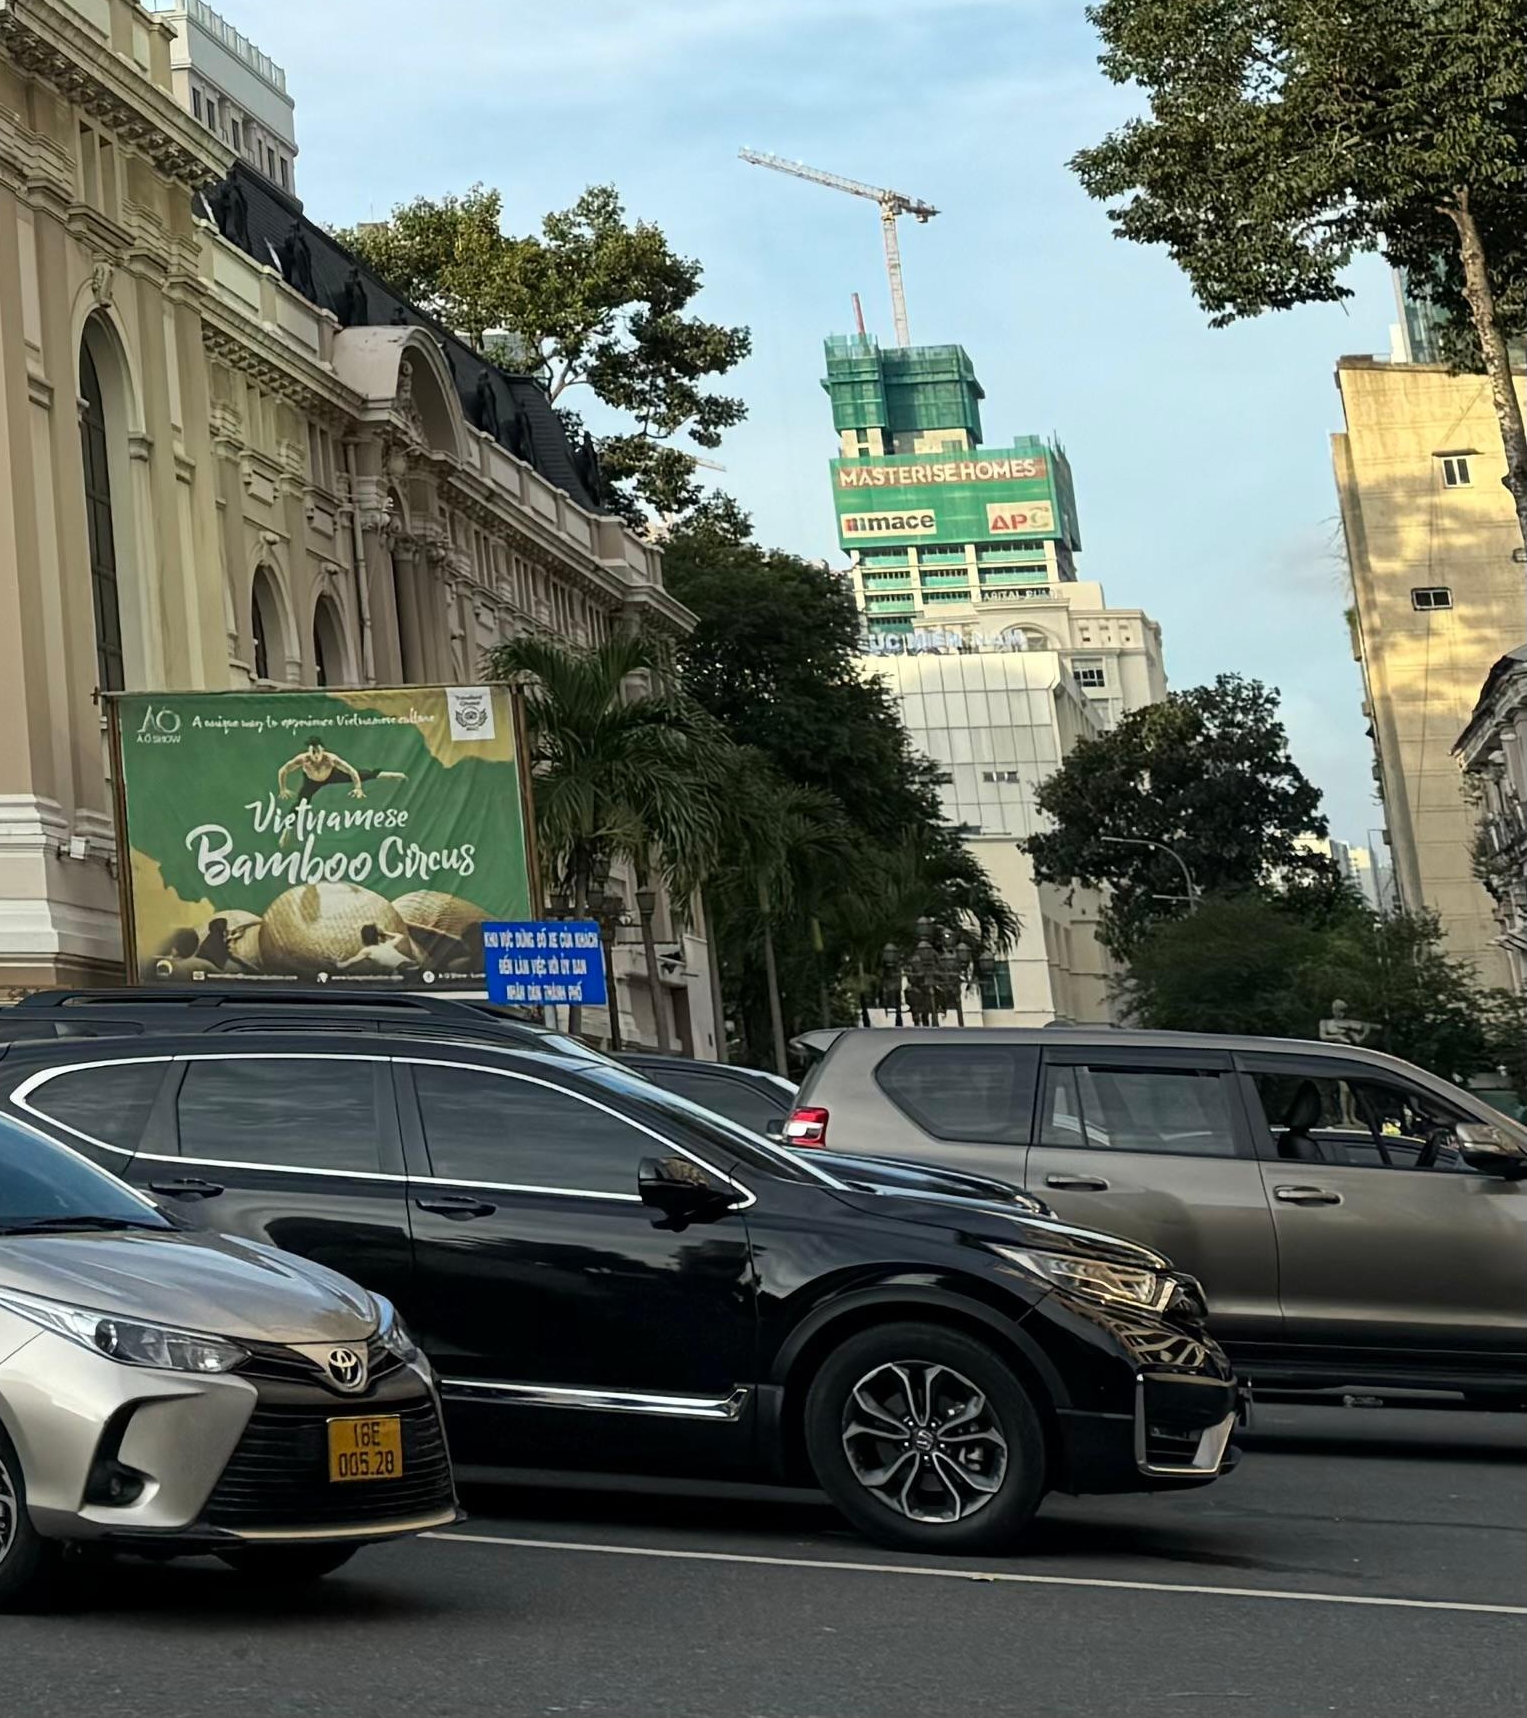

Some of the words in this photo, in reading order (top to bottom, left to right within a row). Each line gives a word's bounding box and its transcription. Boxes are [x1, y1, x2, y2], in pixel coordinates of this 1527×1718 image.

[840, 463, 957, 487] MASTERISE
[960, 458, 1037, 481] HOMES
[868, 514, 935, 532] mace
[266, 715, 278, 729] to
[245, 792, 408, 841] Vietnamese
[186, 824, 373, 886] Bamboo
[378, 836, 476, 880] Circus
[338, 1449, 395, 1478] 005.28
